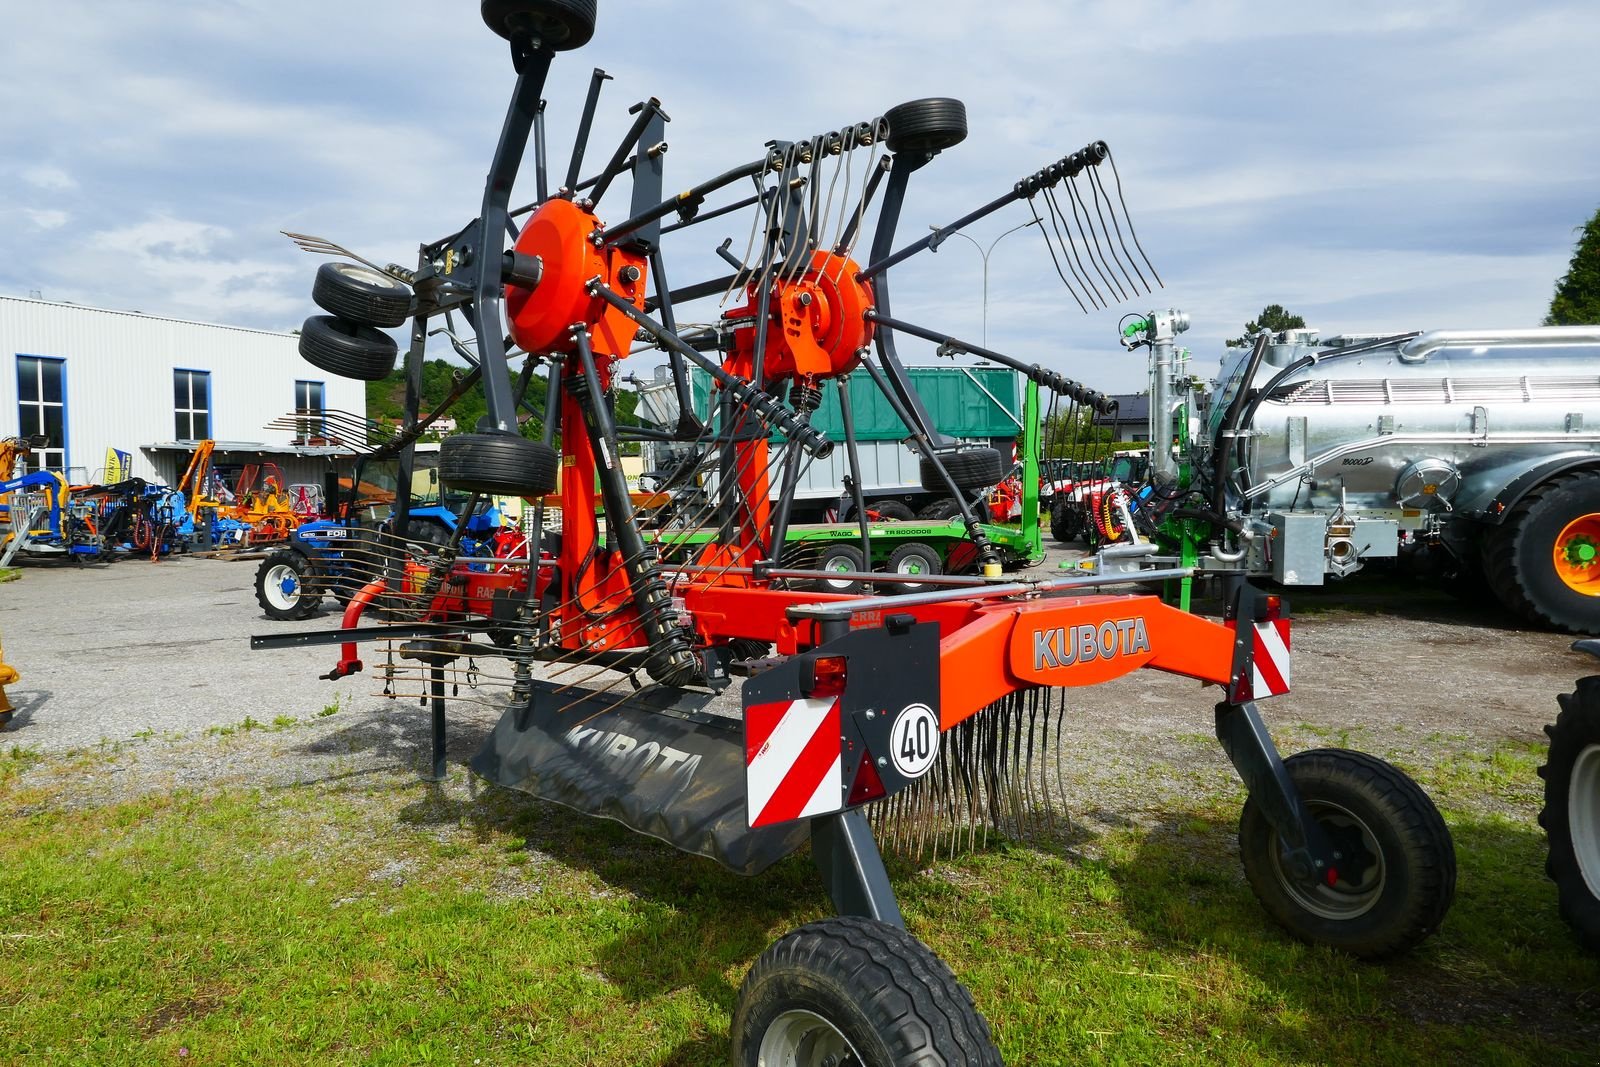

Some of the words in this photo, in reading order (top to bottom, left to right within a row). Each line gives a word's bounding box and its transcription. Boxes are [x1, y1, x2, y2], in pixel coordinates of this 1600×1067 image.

[327, 529, 347, 537] FOR
[476, 586, 496, 599] RA2
[1033, 616, 1151, 671] KUBOTA
[564, 725, 702, 793] KUBOTA
[900, 715, 930, 763] 40
